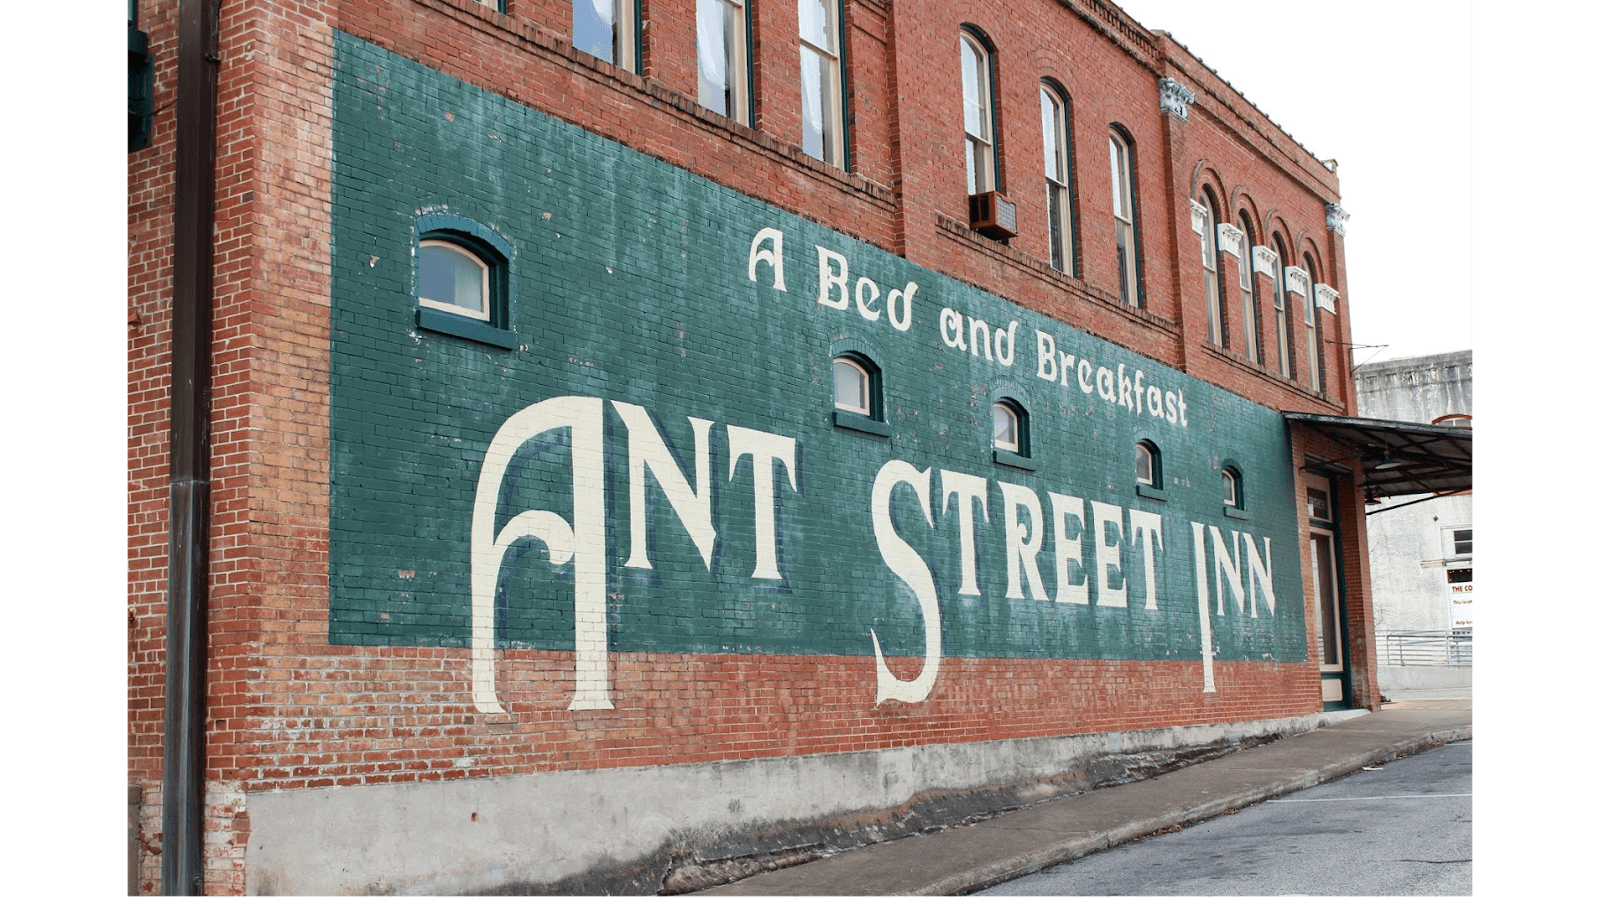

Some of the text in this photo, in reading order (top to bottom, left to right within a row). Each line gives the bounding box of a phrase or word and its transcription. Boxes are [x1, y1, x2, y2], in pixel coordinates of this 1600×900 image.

[748, 226, 1189, 428] A Bed and Breakfast
[470, 395, 1276, 714] ANT STREET INN
